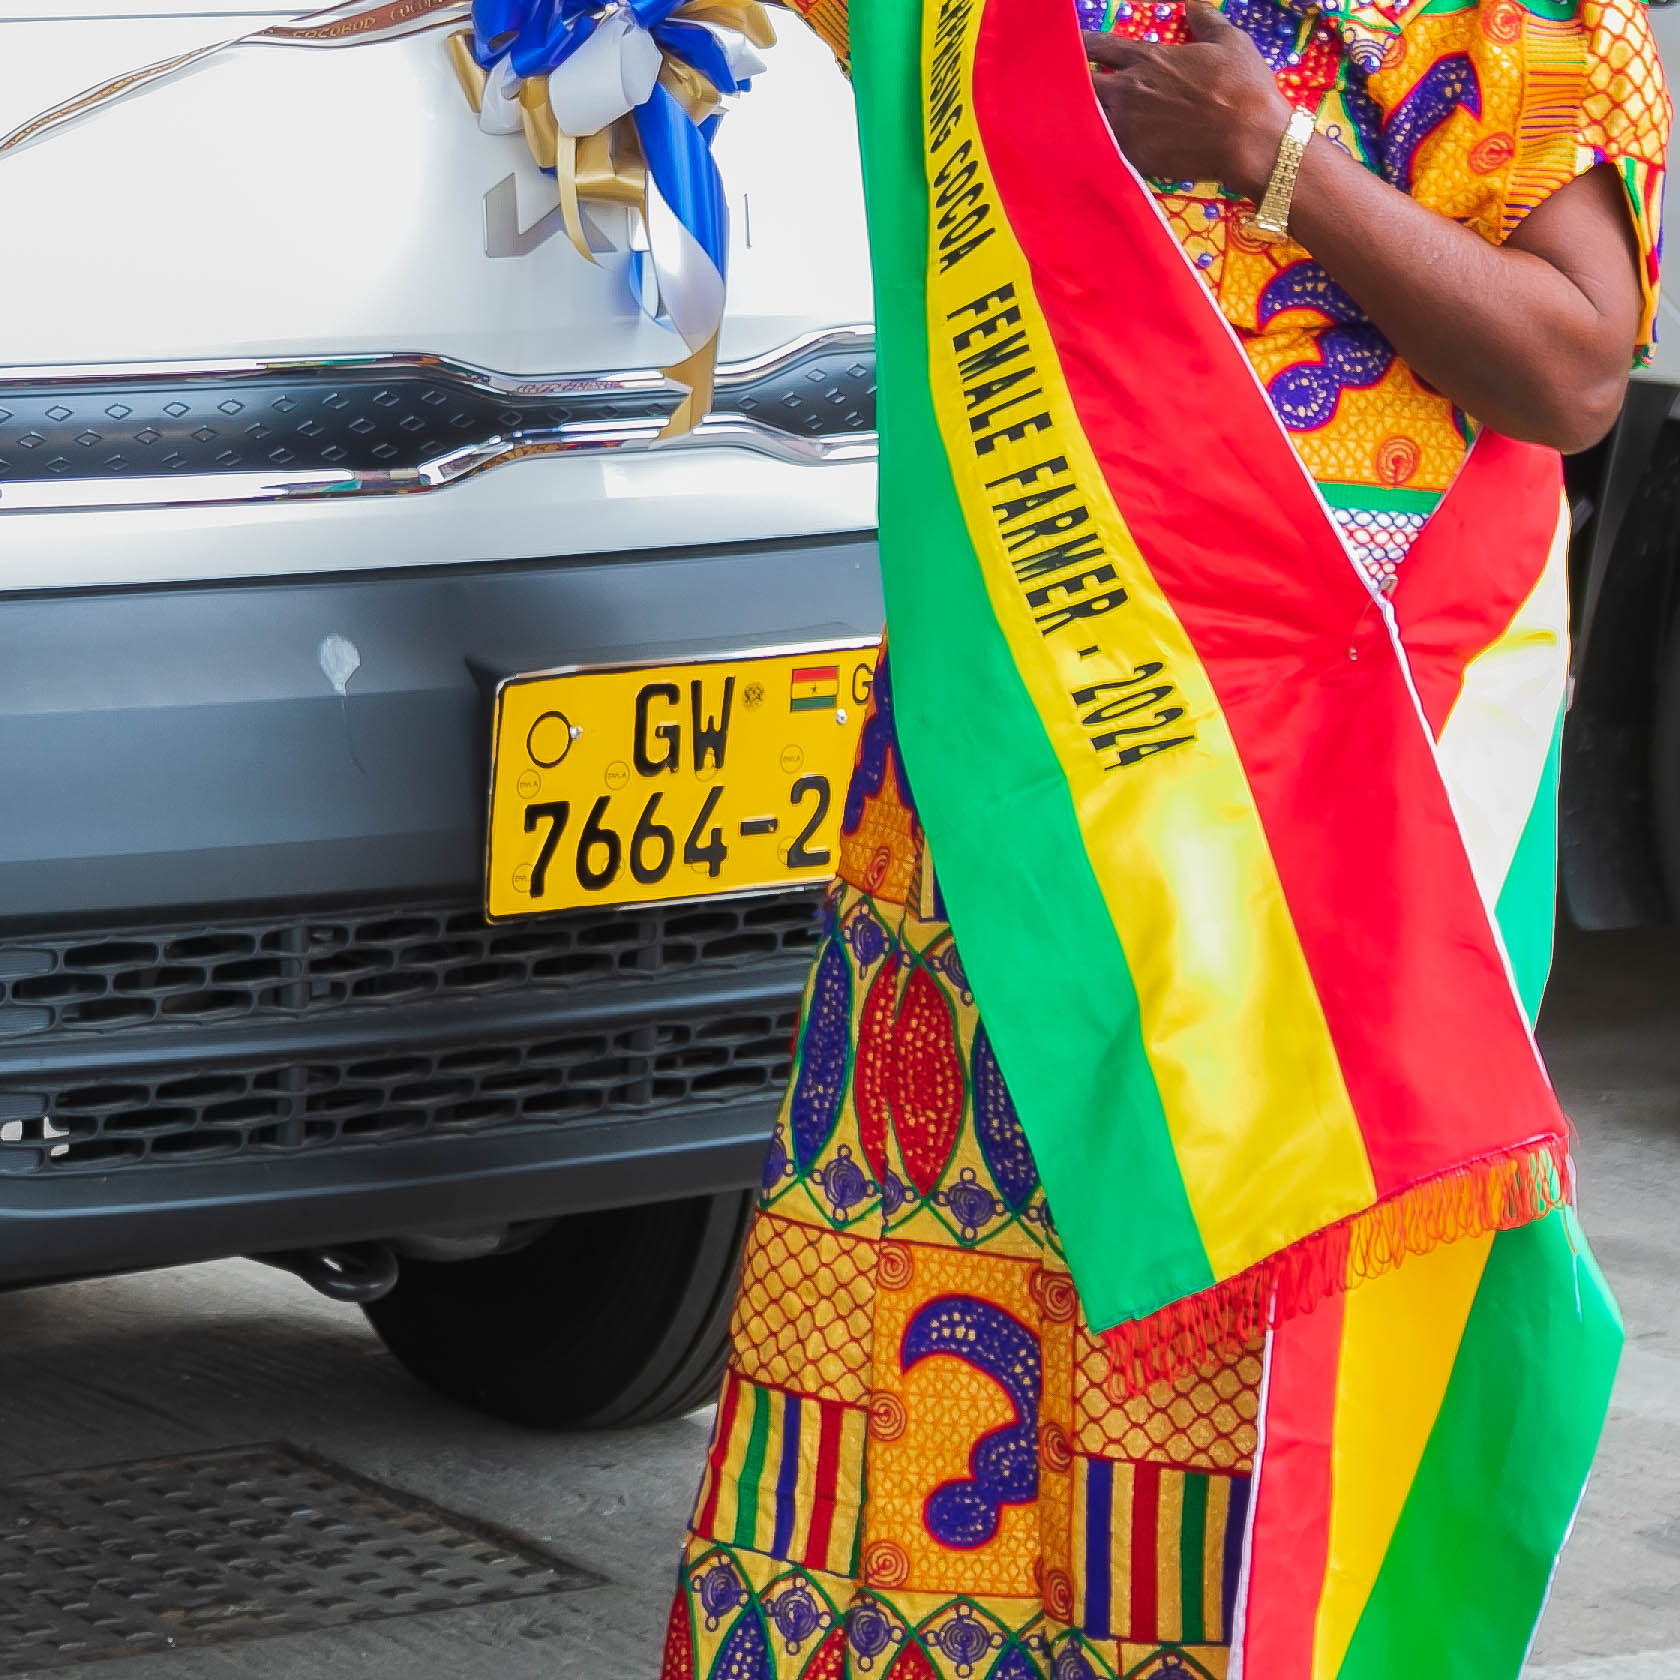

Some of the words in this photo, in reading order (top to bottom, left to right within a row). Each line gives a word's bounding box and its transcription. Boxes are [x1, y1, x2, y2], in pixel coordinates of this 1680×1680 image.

[934, 140, 996, 275] COCOA
[946, 281, 1054, 456] FEMALE
[985, 454, 1130, 638] FARMER
[632, 675, 737, 778] GW
[851, 662, 874, 706] G
[1071, 661, 1198, 772] 2024
[523, 774, 832, 899] 7664-2
